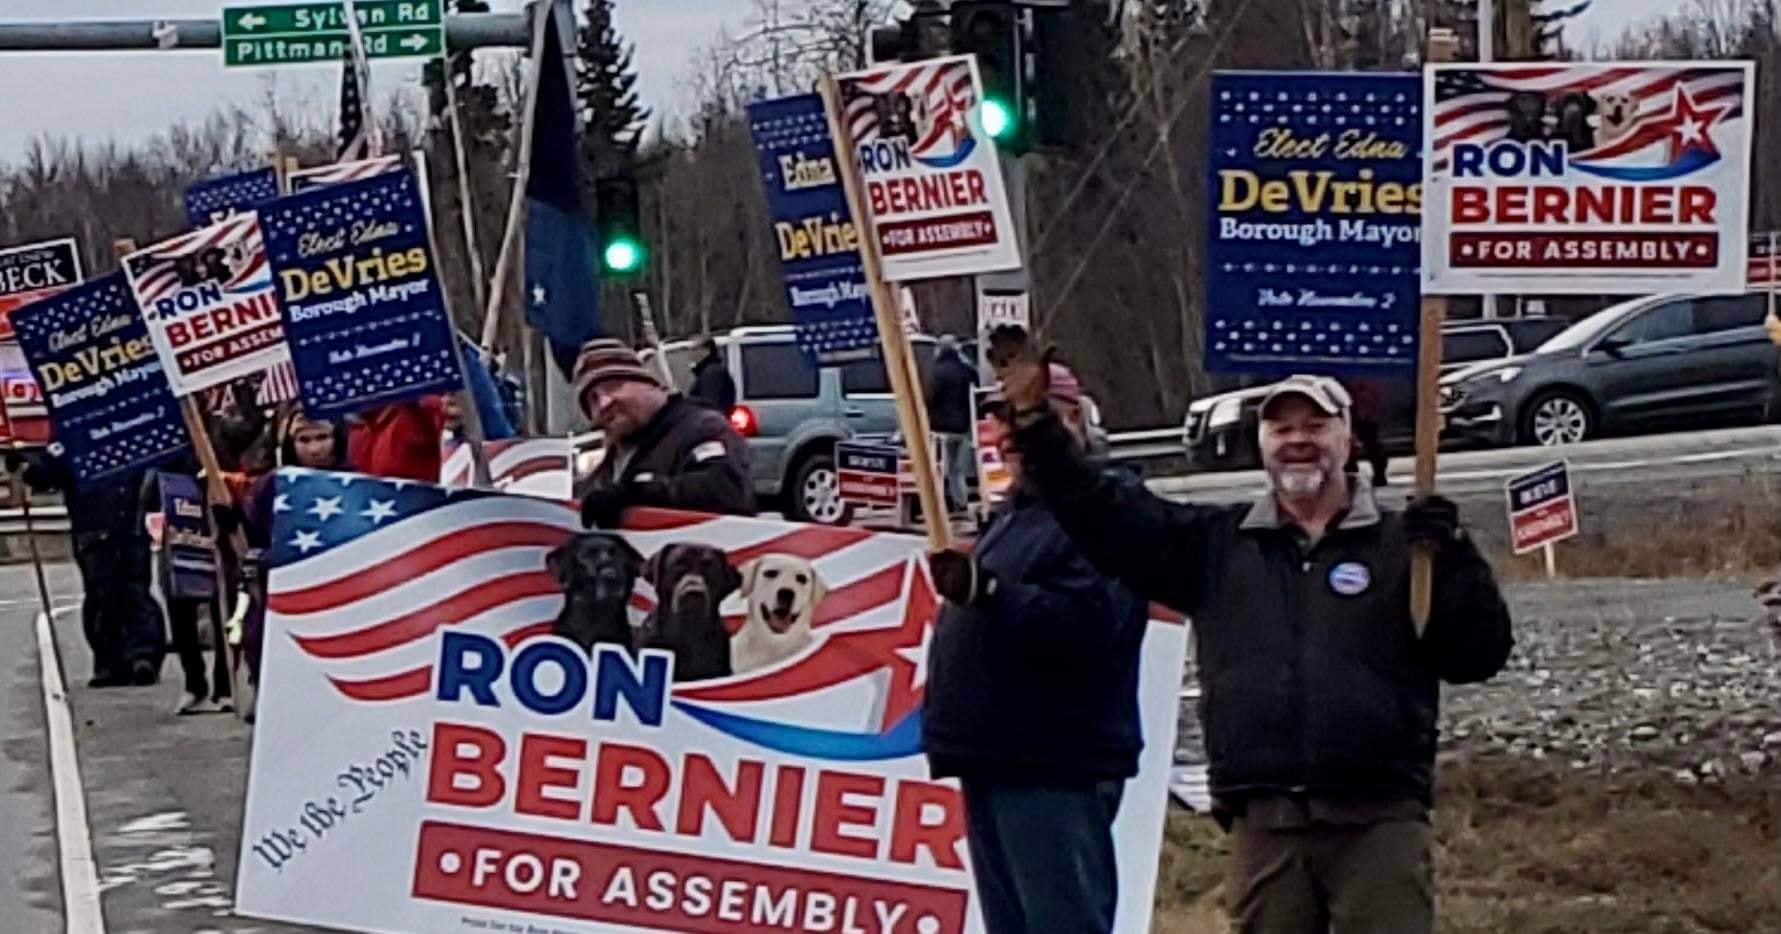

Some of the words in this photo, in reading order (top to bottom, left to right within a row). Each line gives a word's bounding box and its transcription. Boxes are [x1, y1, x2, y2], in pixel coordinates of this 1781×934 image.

[397, 2, 429, 22] Rd
[237, 38, 343, 61] Pittman
[860, 140, 912, 173] RON
[1253, 127, 1330, 158] Elect
[1332, 129, 1407, 159] Edna
[1452, 142, 1566, 178] RON
[868, 169, 988, 216] BERNIER
[1217, 168, 1424, 214] DeVries
[1451, 185, 1718, 225] BERNIER
[1219, 217, 1333, 246] Borough
[1477, 240, 1532, 260] FOR
[1543, 240, 1693, 260] ASSEMBLY
[279, 246, 428, 302] DeVries
[155, 282, 223, 320] RON
[289, 290, 368, 322] Borough
[436, 631, 669, 727] RON
[252, 828, 307, 874] We
[337, 729, 428, 813] People
[426, 721, 968, 871] BERNIER
[472, 848, 582, 898] FOR
[602, 866, 908, 934] ASSEMBLY
